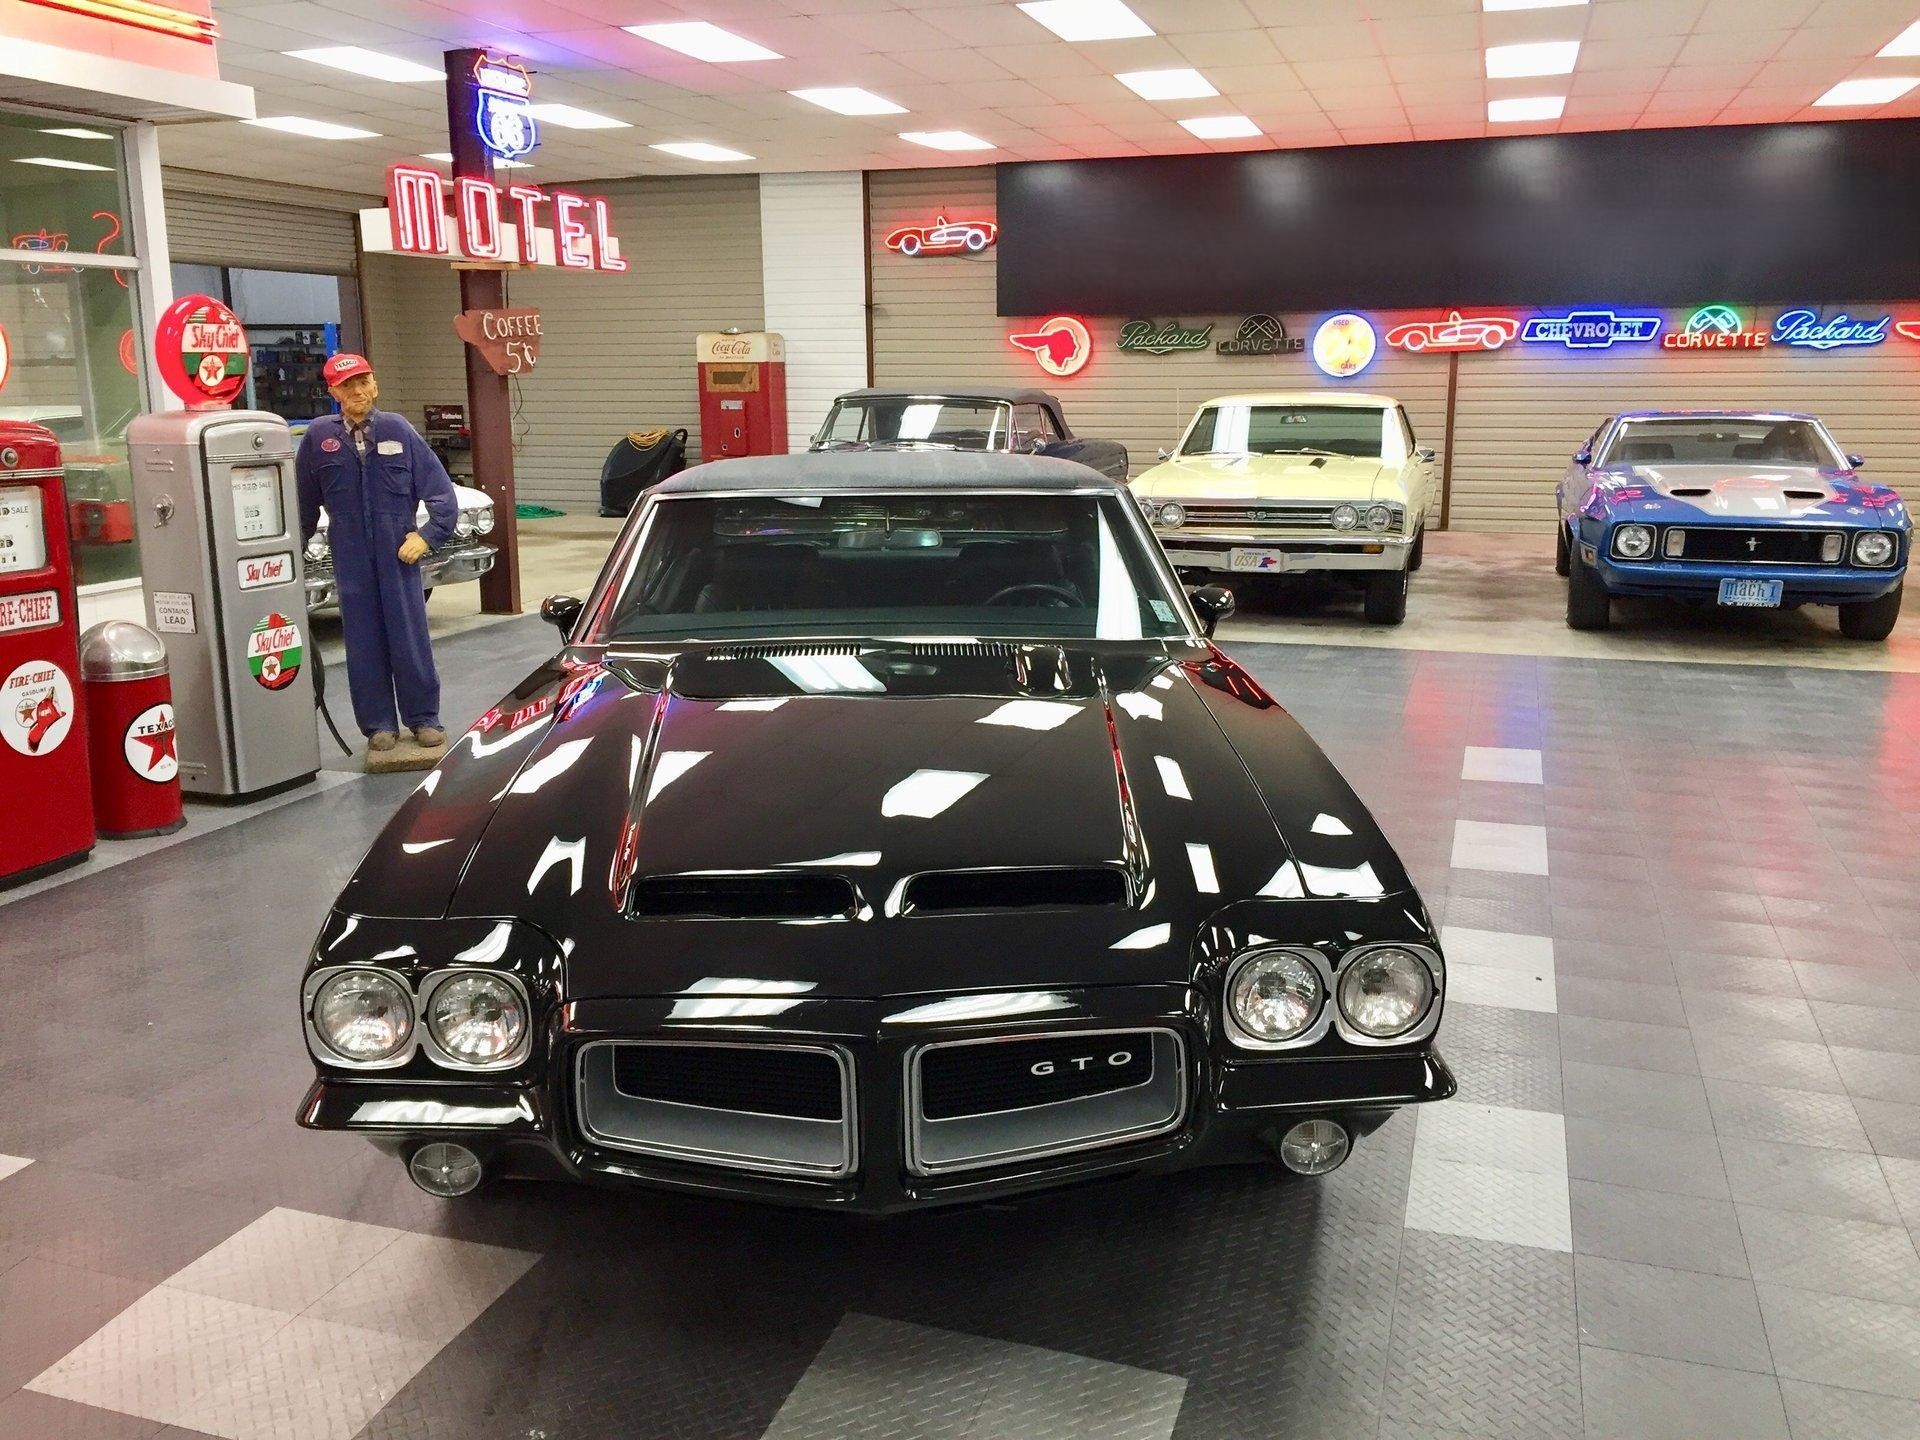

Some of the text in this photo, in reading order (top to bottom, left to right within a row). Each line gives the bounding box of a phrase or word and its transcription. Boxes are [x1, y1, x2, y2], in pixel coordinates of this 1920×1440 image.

[386, 164, 630, 275] MOTEL
[481, 311, 545, 341] COFFEE
[1535, 321, 1644, 339] CHEVROLET
[1771, 310, 1890, 348] Packard
[191, 324, 214, 351] Sky
[1115, 320, 1215, 353] Packard
[1218, 337, 1304, 353] CORVETTE
[1663, 331, 1769, 349] CORVETTE
[11, 505, 29, 515] SALE
[246, 559, 283, 582] Sky Chief
[1233, 555, 1258, 567] USA
[0, 595, 52, 627] RE-CHIEF
[159, 606, 190, 616] CONTAINS
[164, 616, 187, 625] LEAD
[254, 626, 295, 653] Sky Chief
[9, 669, 56, 689] FIRE-CHIEF
[21, 687, 47, 698] GASOLINE
[137, 719, 175, 734] TEXAC
